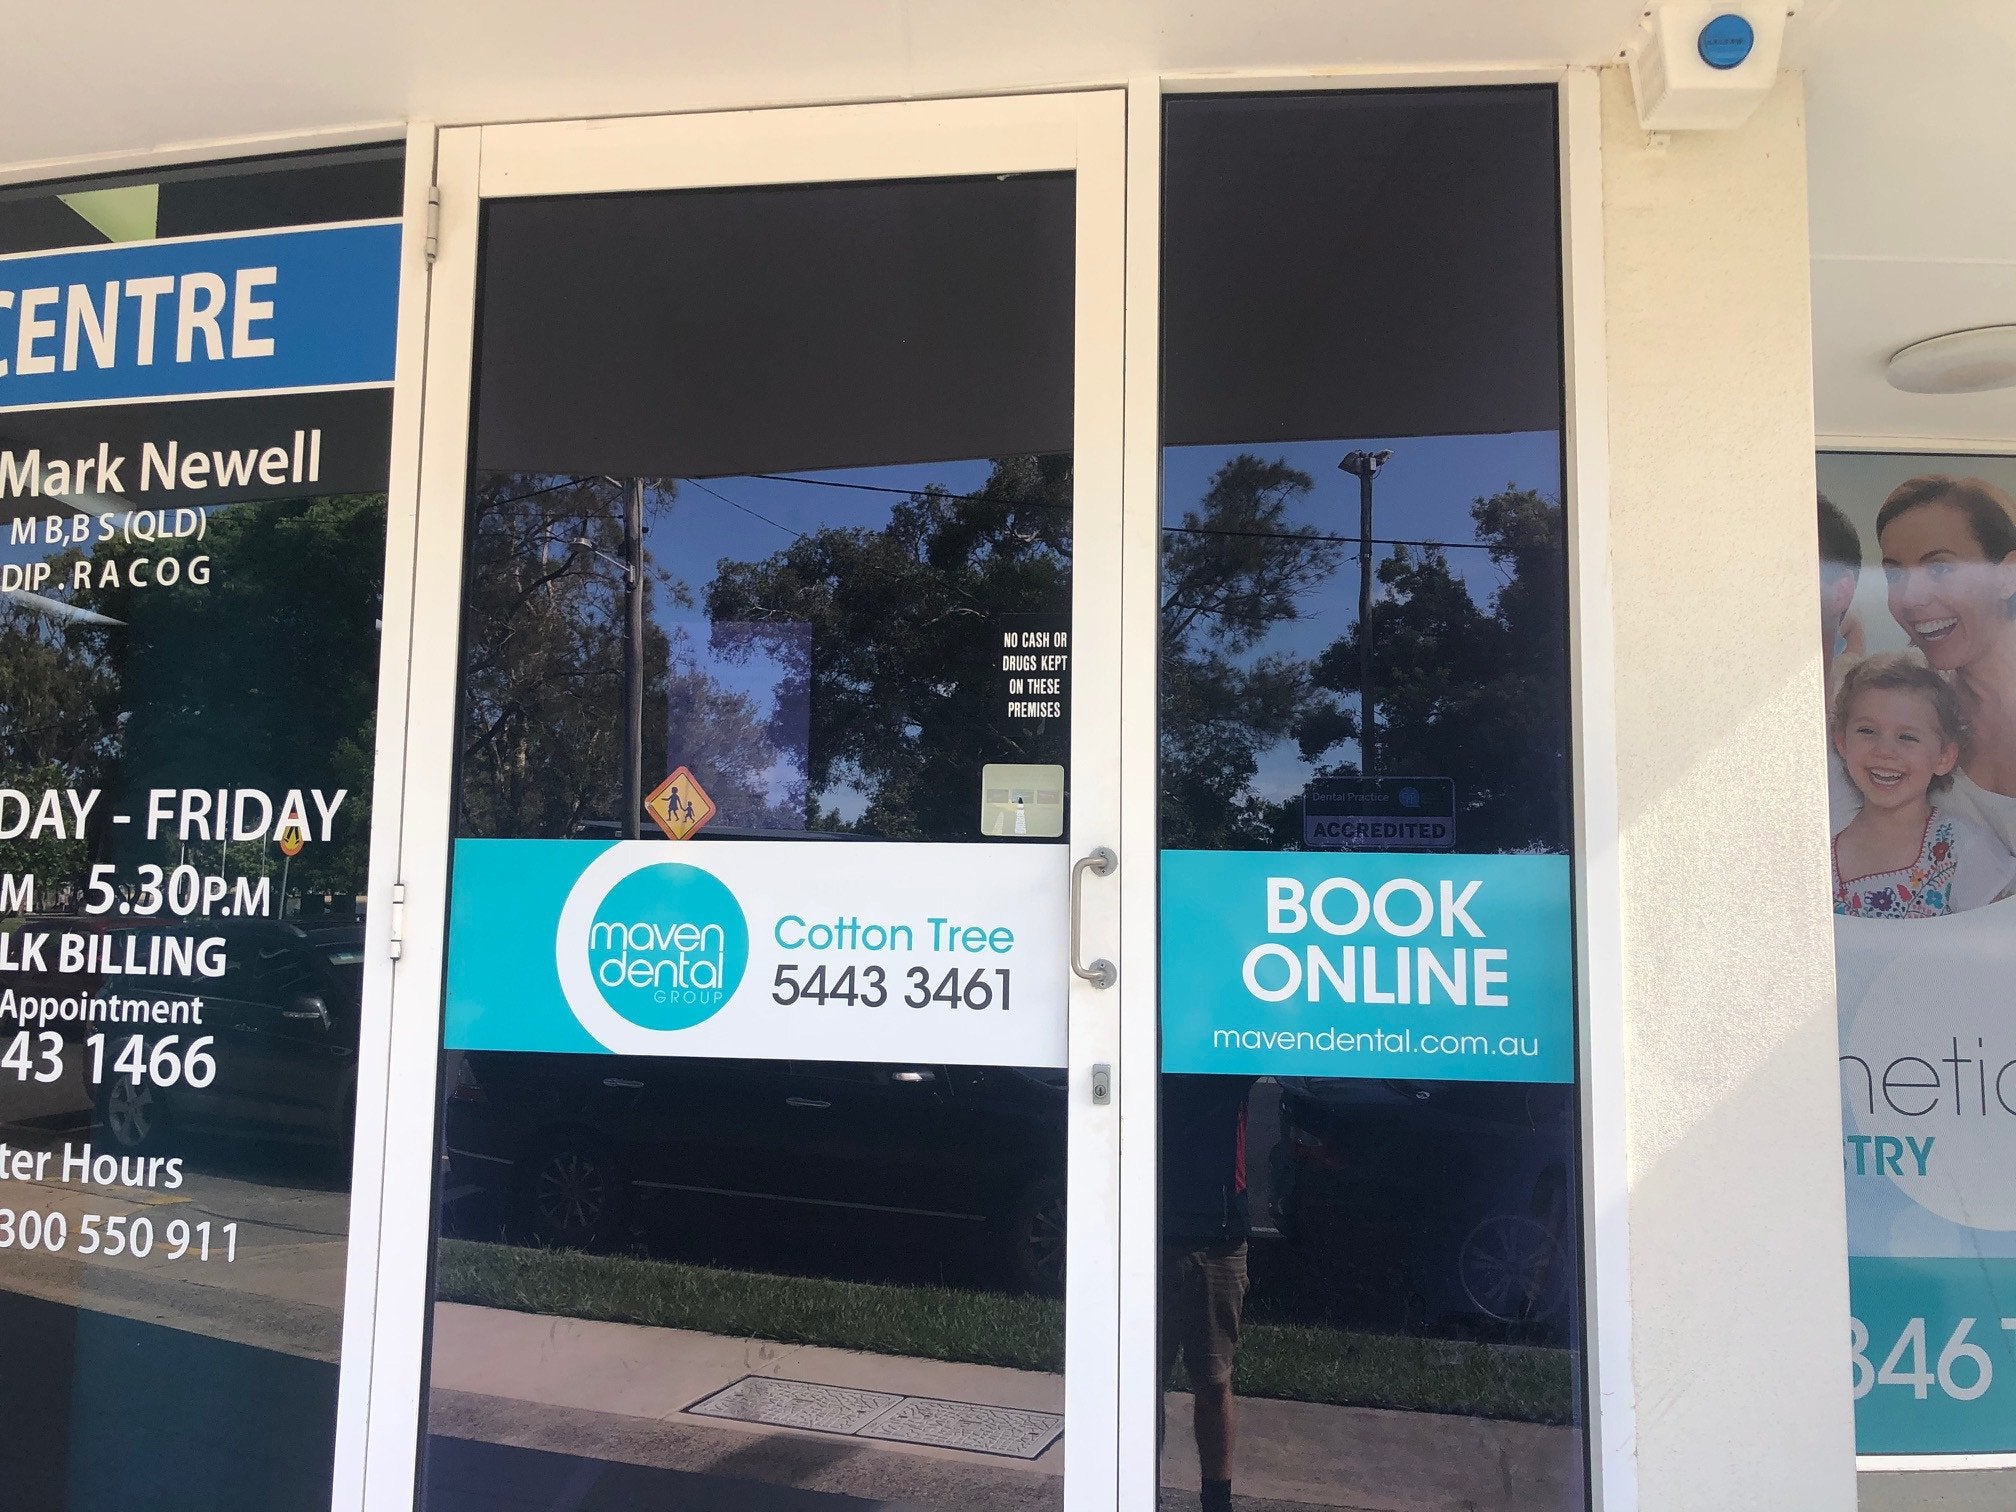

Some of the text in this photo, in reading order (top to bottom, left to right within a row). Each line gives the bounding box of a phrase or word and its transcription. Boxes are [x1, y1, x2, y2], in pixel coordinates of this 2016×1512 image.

[0, 429, 322, 499] Mark Newell
[124, 507, 207, 545] (QLD)
[1003, 632, 1067, 648] NO CASH OR
[1002, 655, 1068, 671] DRUGS KEPT
[1009, 678, 1060, 694] ON THESE
[1008, 702, 1061, 718] PREMISES
[0, 789, 101, 840] DAY
[147, 788, 348, 842] FRIDAY
[1312, 792, 1345, 803] Dental
[1348, 792, 1390, 803] Practice
[1313, 822, 1446, 839] ACCREDITED
[1266, 877, 1486, 938] BOOK
[590, 921, 725, 951] maven
[774, 915, 1015, 953] Cotton Tree
[0, 932, 226, 977] LK BILLING
[599, 951, 724, 989] dental
[772, 964, 1011, 1010] 5443 3461
[1242, 943, 1508, 1007] ONLINE
[0, 988, 204, 1027] Appointment
[653, 990, 724, 1004] GROUP
[1, 1031, 217, 1088] 43 1466
[1213, 1027, 1539, 1057] mavendental.com.au
[62, 1143, 184, 1189] Hours
[1843, 1134, 1936, 1177] TRY
[0, 1208, 238, 1263] 300 550 911
